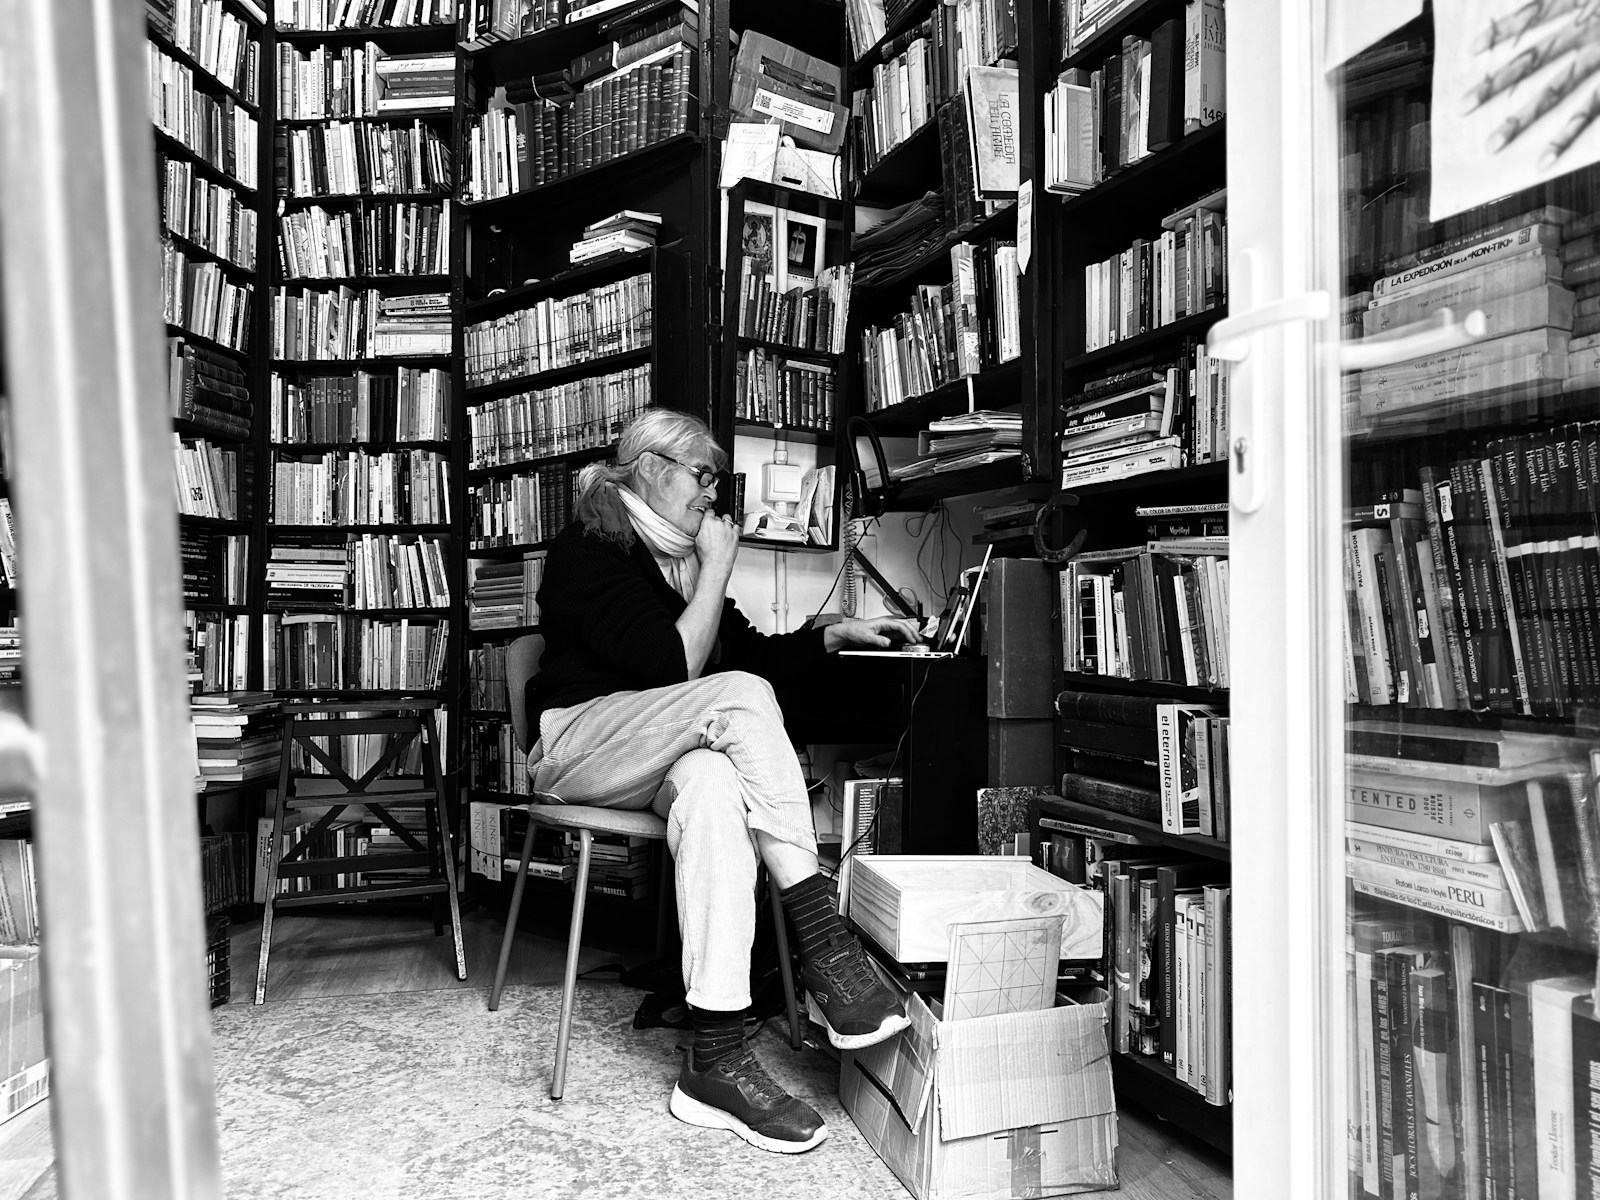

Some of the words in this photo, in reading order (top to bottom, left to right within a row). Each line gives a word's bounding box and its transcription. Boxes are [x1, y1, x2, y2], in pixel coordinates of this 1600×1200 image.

[1001, 112, 1015, 164] COMEDIA
[1389, 277, 1402, 287] LA
[1401, 258, 1454, 283] EXPEDICIÓN
[1535, 447, 1548, 472] Frans
[1555, 441, 1571, 469] Rafael
[1493, 454, 1507, 484] Picasso
[1505, 451, 1520, 485] Holbein
[1523, 449, 1540, 485] Hogarth
[1568, 439, 1591, 491] Grünewald
[1539, 472, 1552, 493] Hals
[1498, 484, 1510, 502] azul
[1171, 506, 1197, 514] PUBLICIDAD
[1503, 511, 1513, 529] rosa
[1352, 535, 1361, 568] JOHNSON
[1447, 525, 1460, 570] ARQUITECTURA
[1455, 572, 1462, 581] LA
[1517, 602, 1525, 614] DEL
[1529, 600, 1537, 612] DEL
[1549, 598, 1557, 610] DEL
[1560, 598, 1568, 610] DEL
[1520, 616, 1529, 632] ARTE
[1531, 613, 1540, 630] ARTE
[1551, 612, 1560, 629] ARTE
[1562, 612, 1571, 629] ARTE
[1583, 610, 1591, 626] ARTE
[1465, 629, 1471, 637] DE
[1466, 639, 1478, 683] ARQUEOLOGIA
[1161, 715, 1170, 726] el
[1161, 728, 1176, 789] eternauta
[1378, 980, 1386, 992] 30
[1379, 1016, 1387, 1030] los
[1380, 1030, 1388, 1041] en
[1380, 1042, 1389, 1077] POLITICO
[1404, 1053, 1414, 1107] CAVANILLES
[1380, 1078, 1392, 1129] COMPROMISO
[1591, 1090, 1600, 1110] seu
[1406, 1107, 1414, 1115] A
[1589, 1110, 1600, 1121] el
[1382, 1129, 1391, 1137] Y
[1407, 1115, 1416, 1154] FLORALS
[1381, 1138, 1393, 1183] LITERATURA
[1409, 1155, 1418, 1178] JOCS
